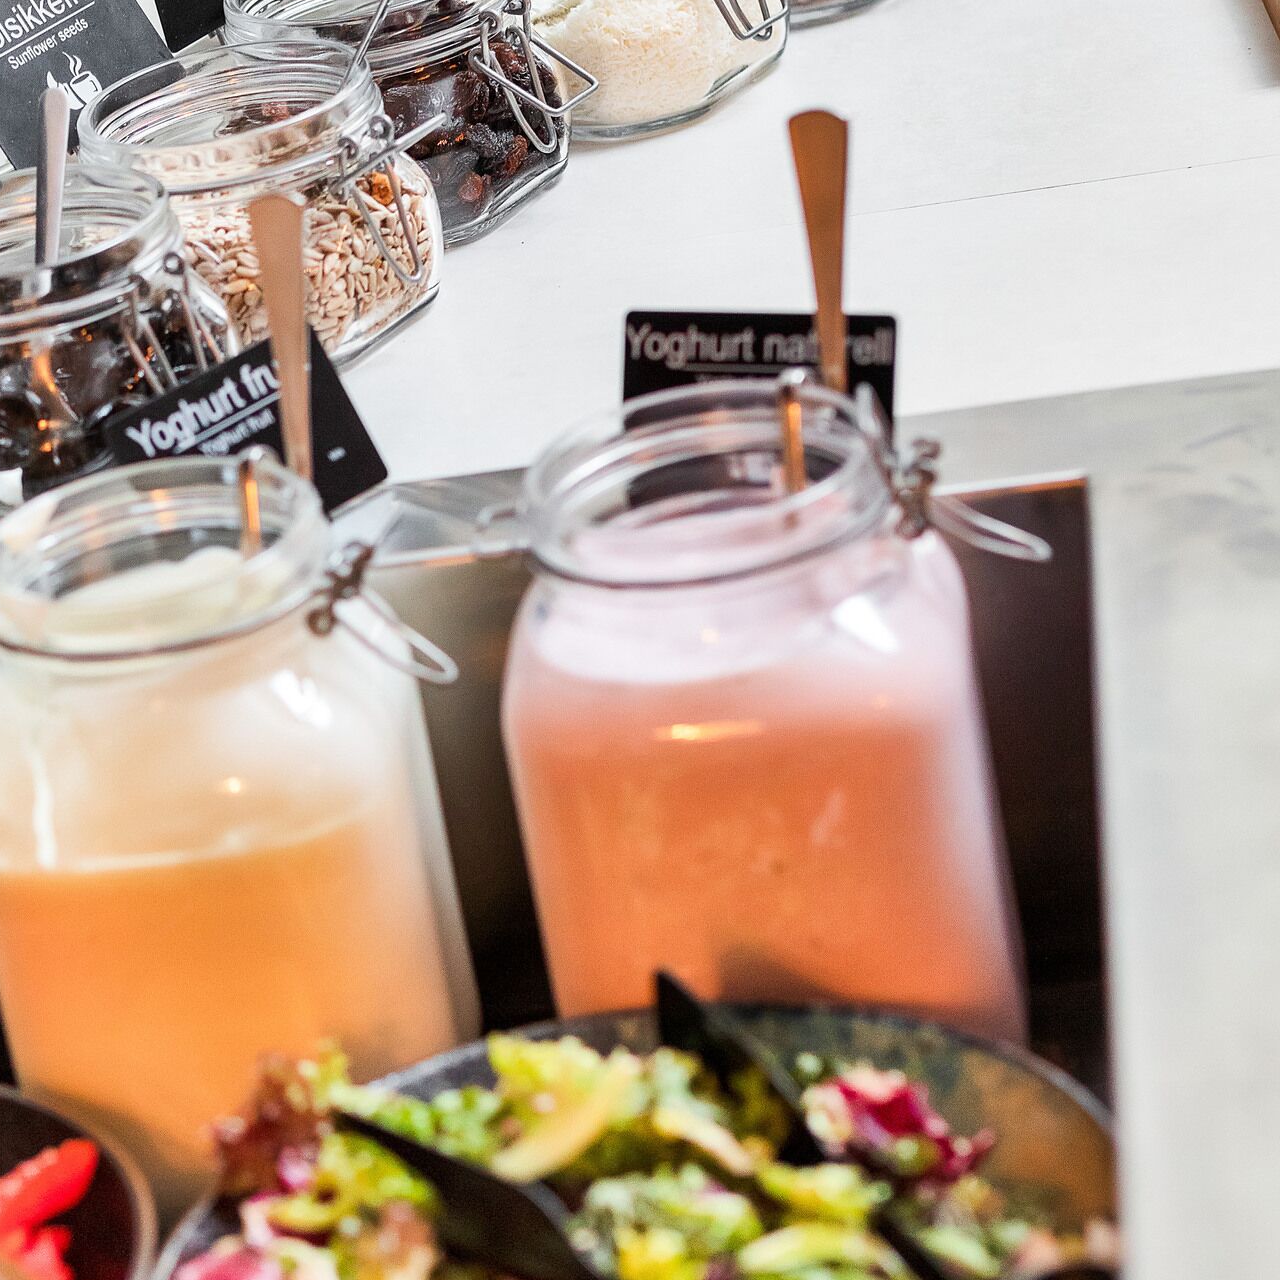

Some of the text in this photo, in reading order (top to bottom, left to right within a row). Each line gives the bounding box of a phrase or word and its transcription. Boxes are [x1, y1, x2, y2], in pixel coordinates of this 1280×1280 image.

[7, 18, 89, 70] Sunflower seeds
[625, 323, 755, 370] Yoghurt
[125, 376, 247, 458] Yoghurt
